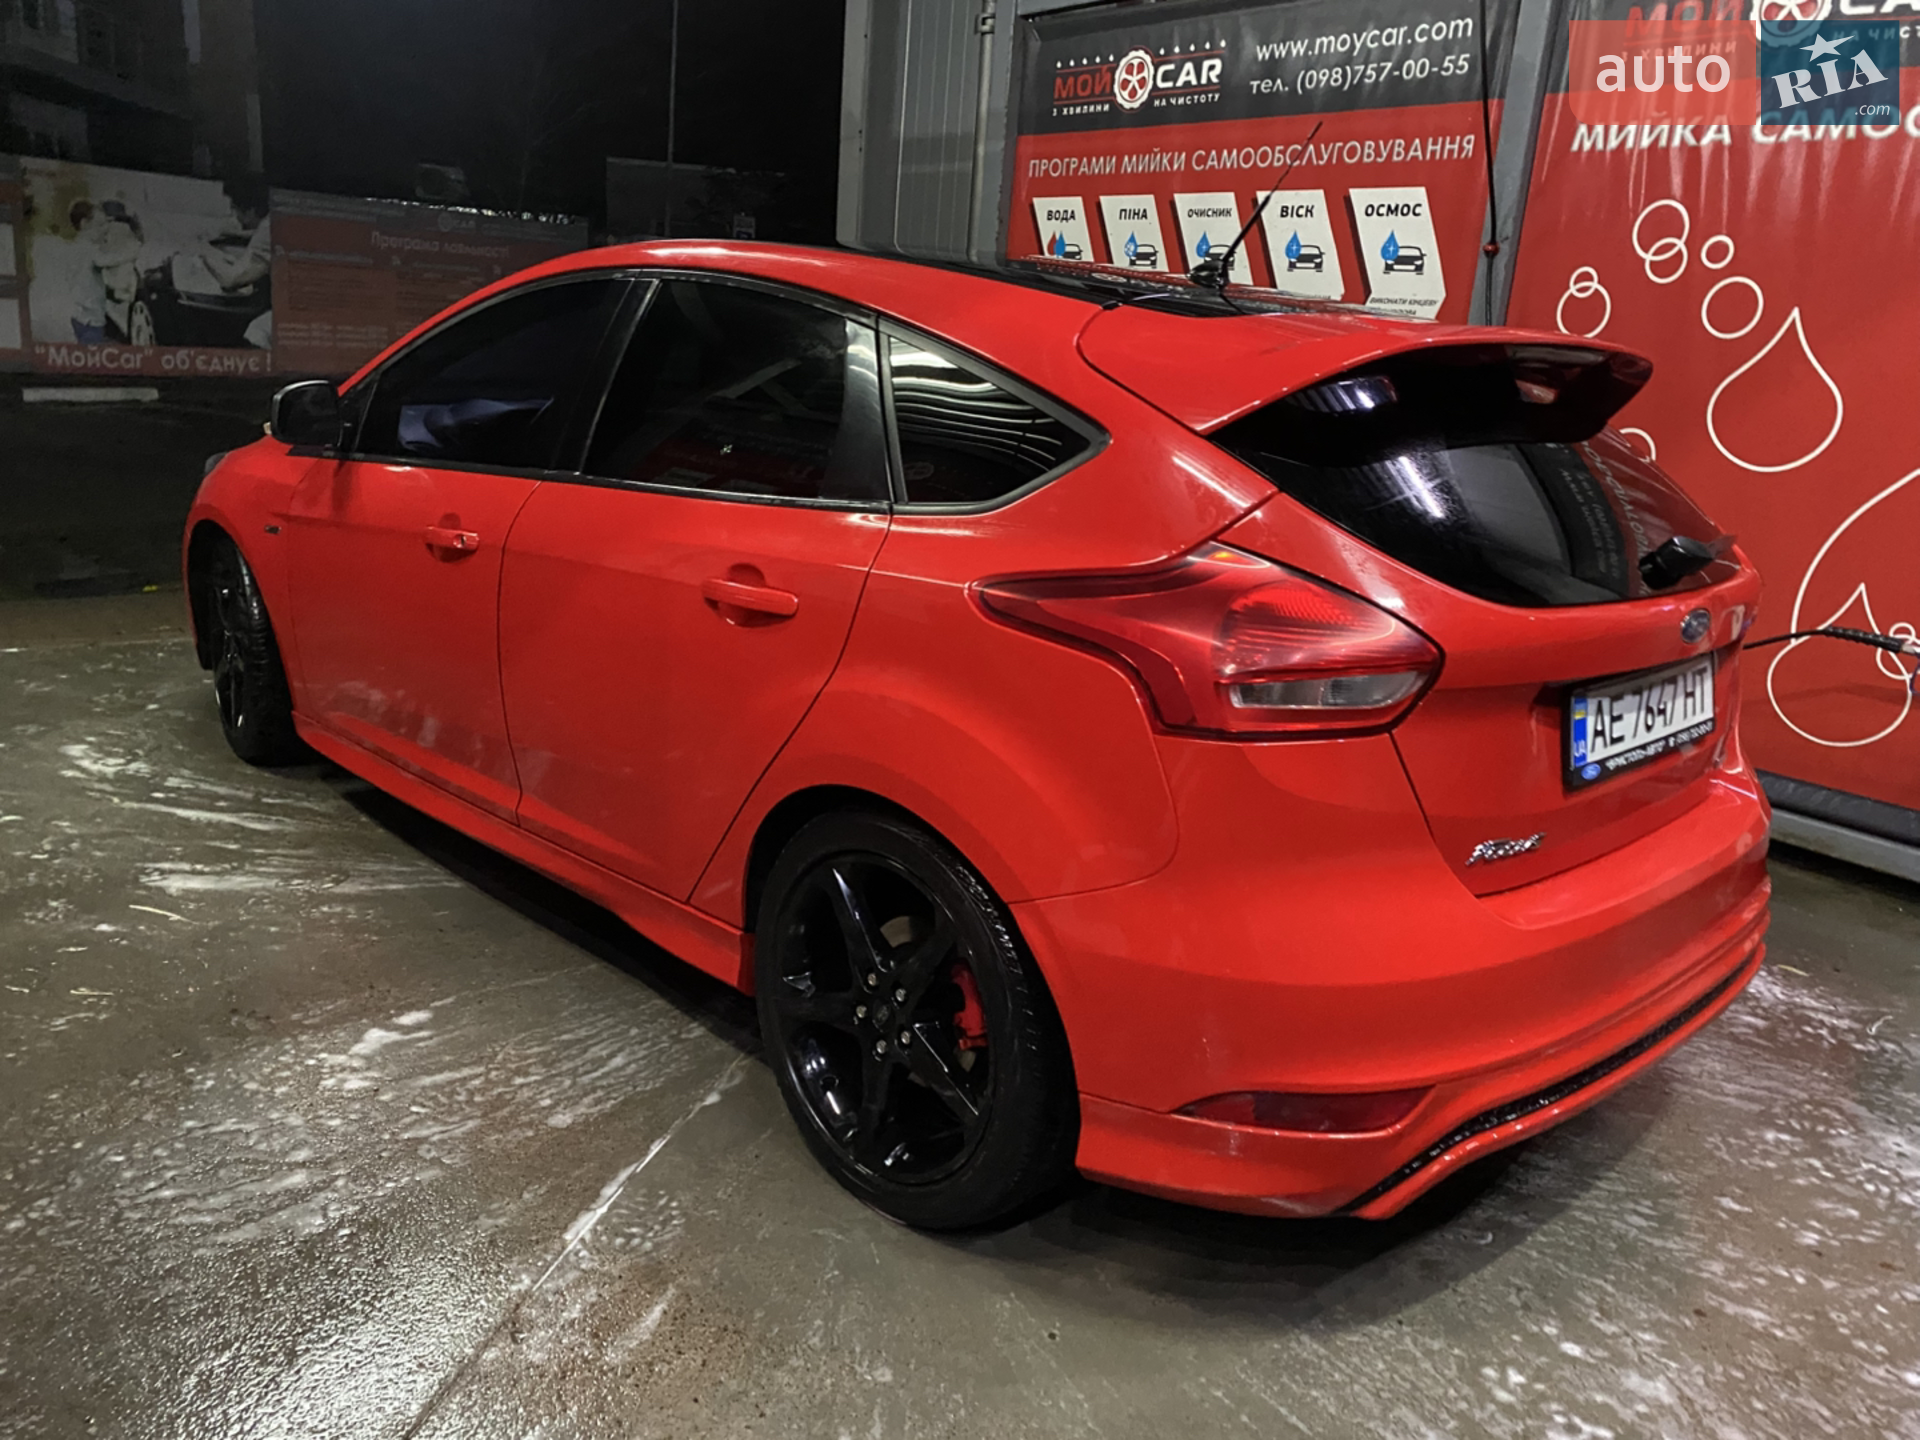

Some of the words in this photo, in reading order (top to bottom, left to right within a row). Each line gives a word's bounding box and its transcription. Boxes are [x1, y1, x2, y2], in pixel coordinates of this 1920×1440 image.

[1256, 17, 1474, 62] www.moycar.com
[1053, 66, 1112, 100] МОЙ
[1155, 58, 1223, 89] CAR
[1249, 76, 1290, 94] тел.
[1296, 53, 1471, 95] (098)757-00-55
[1061, 103, 1111, 116] ХВИЛИНИ
[1153, 98, 1168, 108] НА
[1170, 92, 1221, 107] ЧИСТОТУ
[1570, 110, 1733, 152] МИЙКА
[1028, 155, 1117, 178] ПРОГРАМИ
[1120, 148, 1187, 175] МИЙКИ
[1191, 133, 1476, 172] САМООБСЛУГОВУВАННЯ
[1046, 208, 1077, 223] ВОДА
[1118, 207, 1149, 221] ПІНА
[1187, 206, 1234, 219] ОЧИСНИК
[1279, 204, 1315, 219] ВІСК
[1363, 203, 1423, 218] ОСМОС
[1591, 694, 1626, 754] AE
